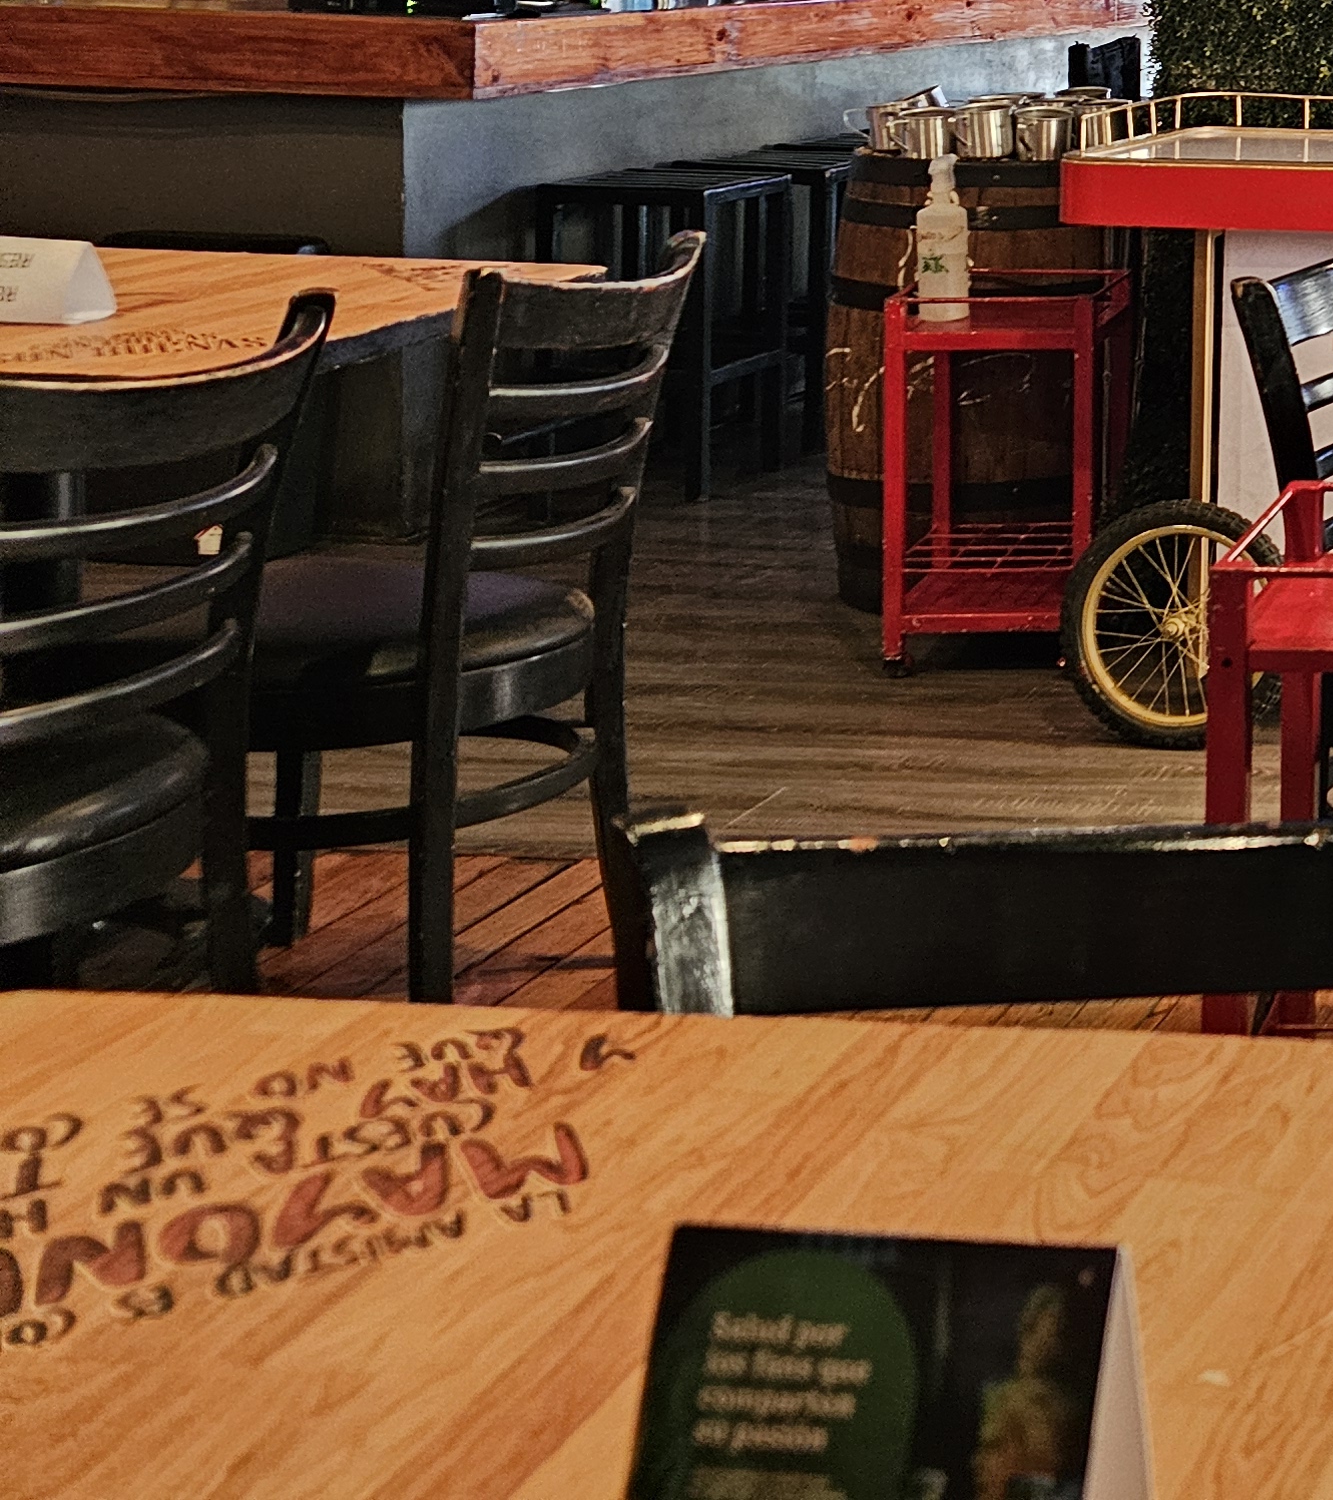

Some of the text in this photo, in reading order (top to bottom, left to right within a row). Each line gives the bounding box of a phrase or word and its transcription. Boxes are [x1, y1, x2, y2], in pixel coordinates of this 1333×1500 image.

[252, 1056, 353, 1100] NO
[360, 1052, 534, 1120] HAY
[97, 1169, 206, 1216] UN
[498, 1188, 571, 1223] LA
[0, 1121, 589, 1315] MAYON
[214, 1209, 467, 1297] AMISTAD
[112, 1285, 174, 1320] ES
